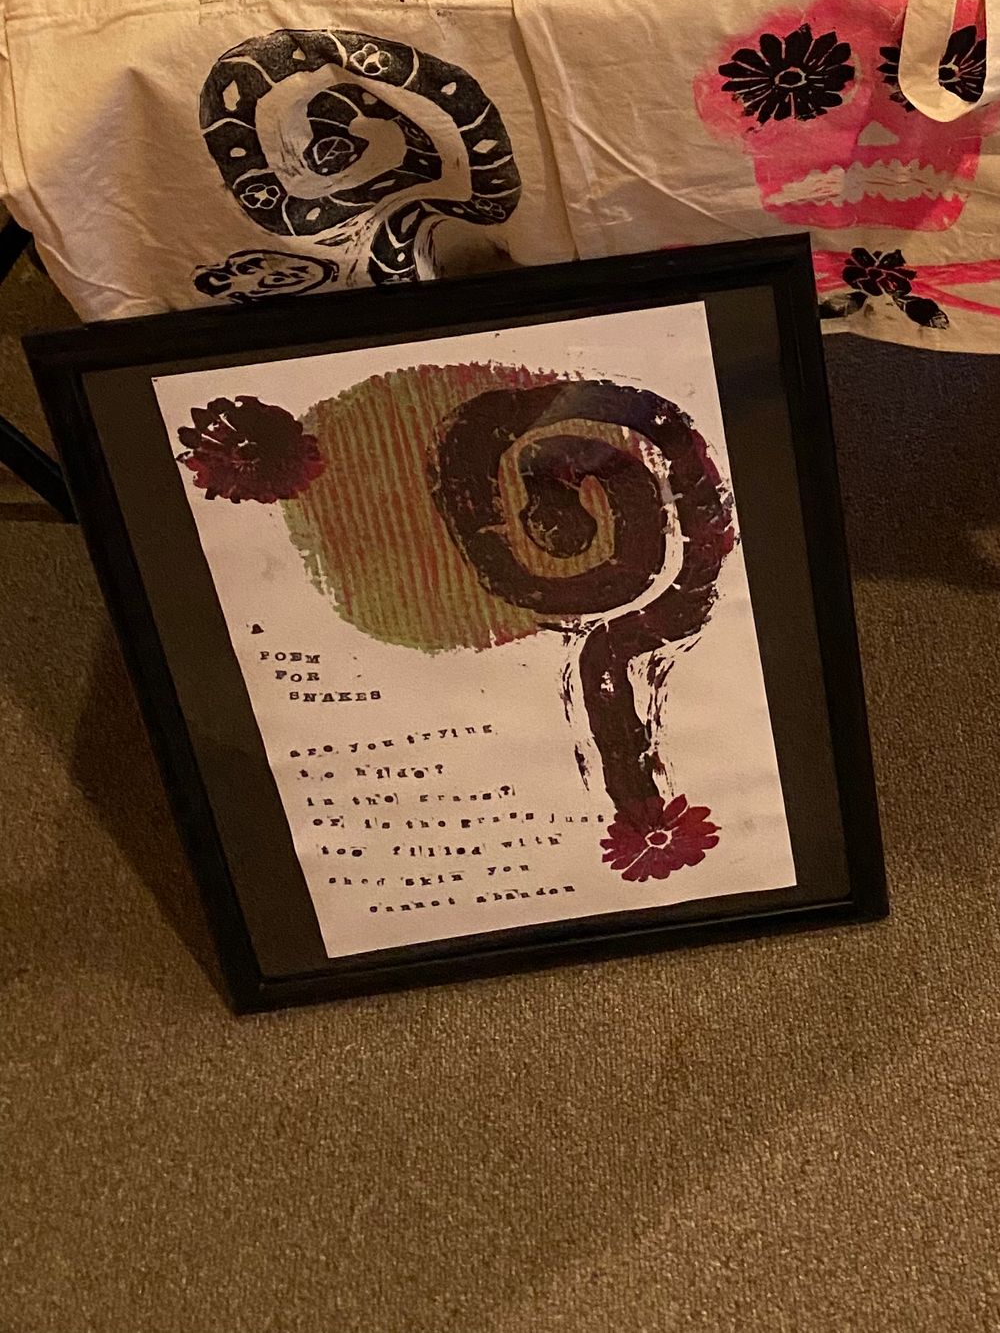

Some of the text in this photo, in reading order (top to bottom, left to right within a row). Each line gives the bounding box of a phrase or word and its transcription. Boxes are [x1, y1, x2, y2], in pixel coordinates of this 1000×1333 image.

[260, 651, 321, 664] POEM
[275, 670, 320, 683] FOR
[289, 690, 381, 703] SNAKES
[349, 739, 394, 753] you
[406, 724, 493, 744] trying
[299, 769, 334, 779] to
[549, 812, 605, 824] just
[501, 835, 561, 850] with
[403, 872, 464, 887] skin
[487, 864, 530, 876] you
